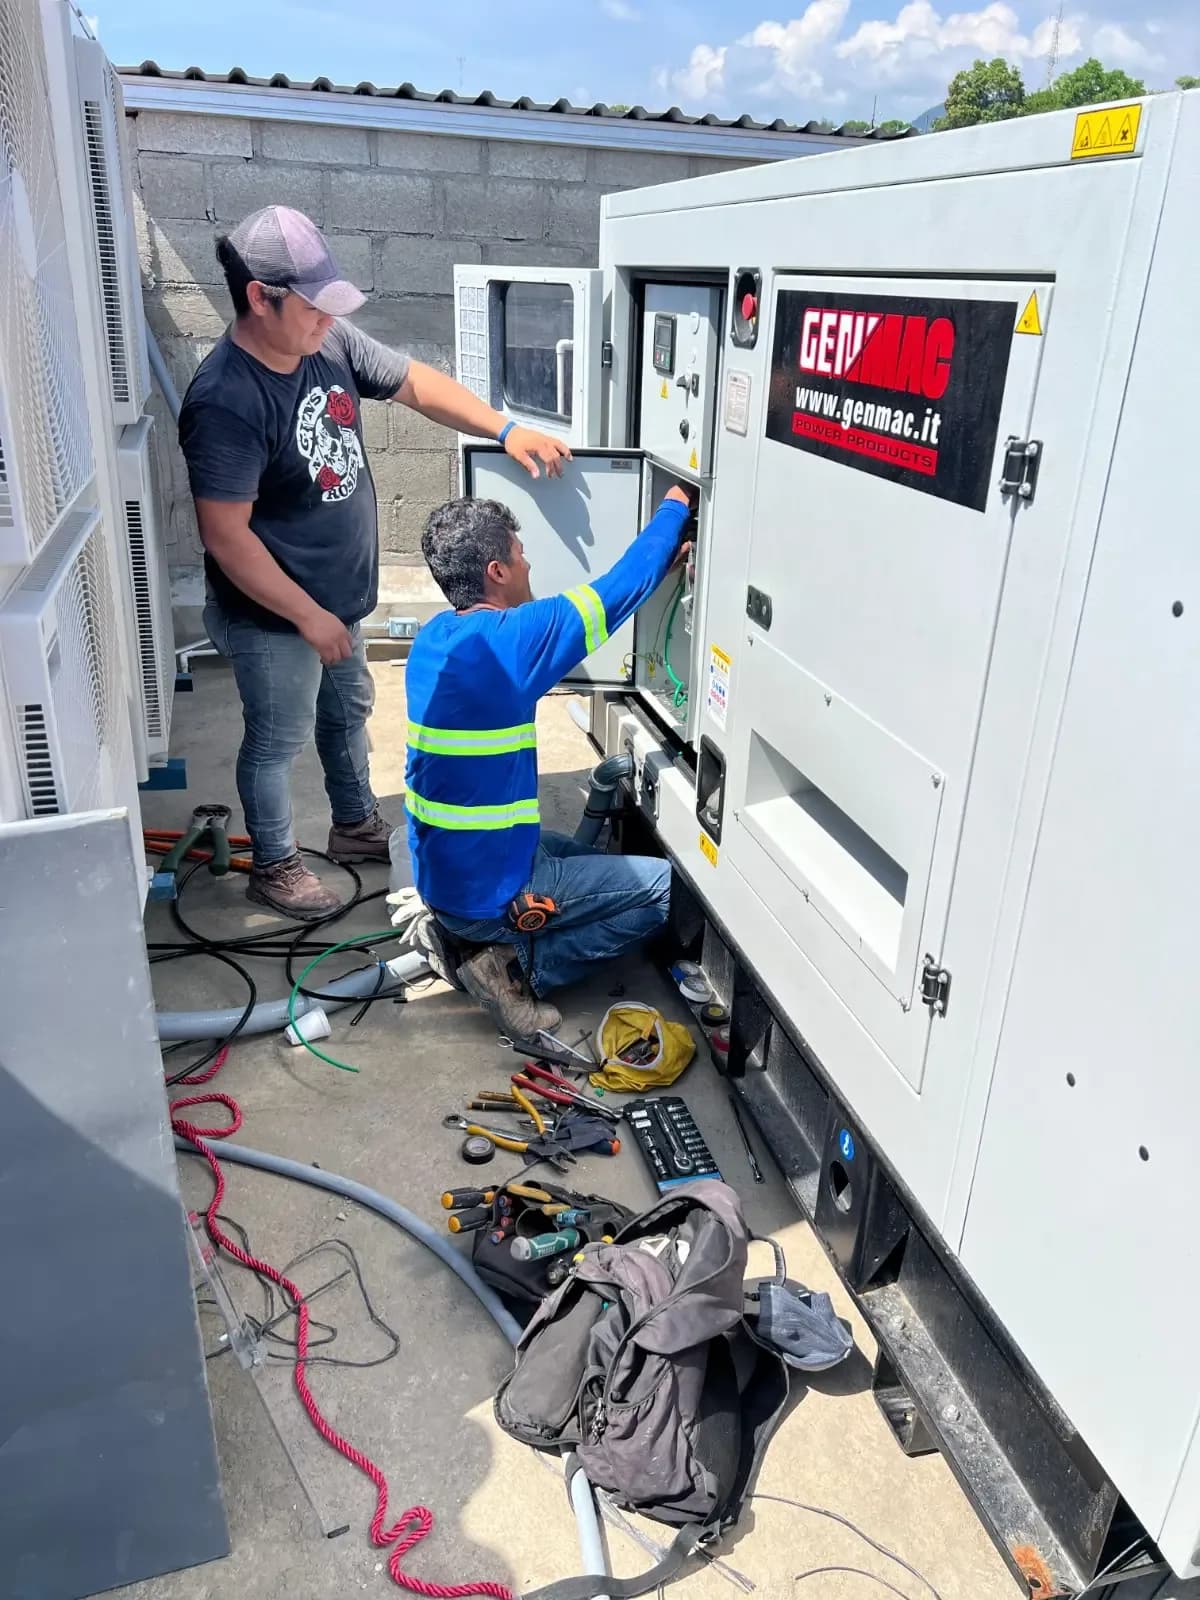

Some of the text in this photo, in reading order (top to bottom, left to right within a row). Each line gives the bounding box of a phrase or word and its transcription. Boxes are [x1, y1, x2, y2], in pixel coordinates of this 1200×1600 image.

[799, 307, 956, 400] GENMAC
[299, 392, 322, 452] GUNS
[795, 386, 942, 444] www.genmac.it
[795, 418, 933, 468] POWER PRODUCTS
